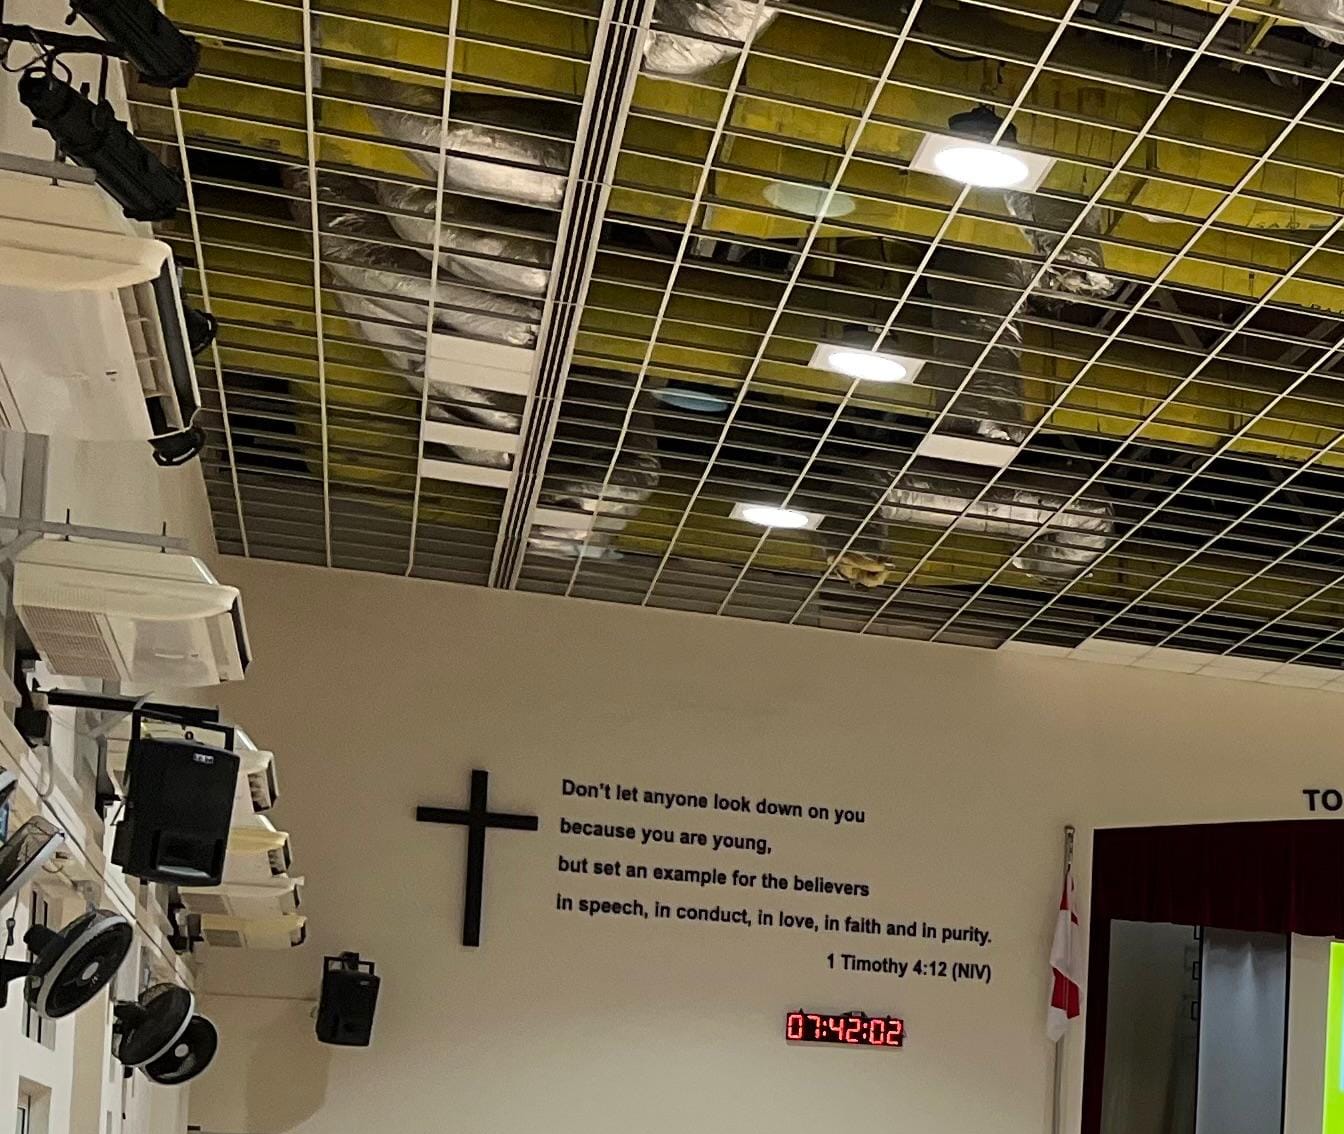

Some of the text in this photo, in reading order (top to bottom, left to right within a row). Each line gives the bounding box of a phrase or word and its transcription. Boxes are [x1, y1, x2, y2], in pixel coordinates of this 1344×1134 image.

[561, 778, 865, 825] Don't let anyone look down on you
[1302, 788, 1343, 812] TO
[559, 816, 772, 856] because you are young,
[558, 854, 870, 897] but set an example for the believers
[556, 892, 992, 947] in speech, in conduct, in love, in faith and in purity.
[826, 952, 992, 985] 1 Timothy 4:12 (NIV)
[787, 1014, 902, 1046] 07:42:02
